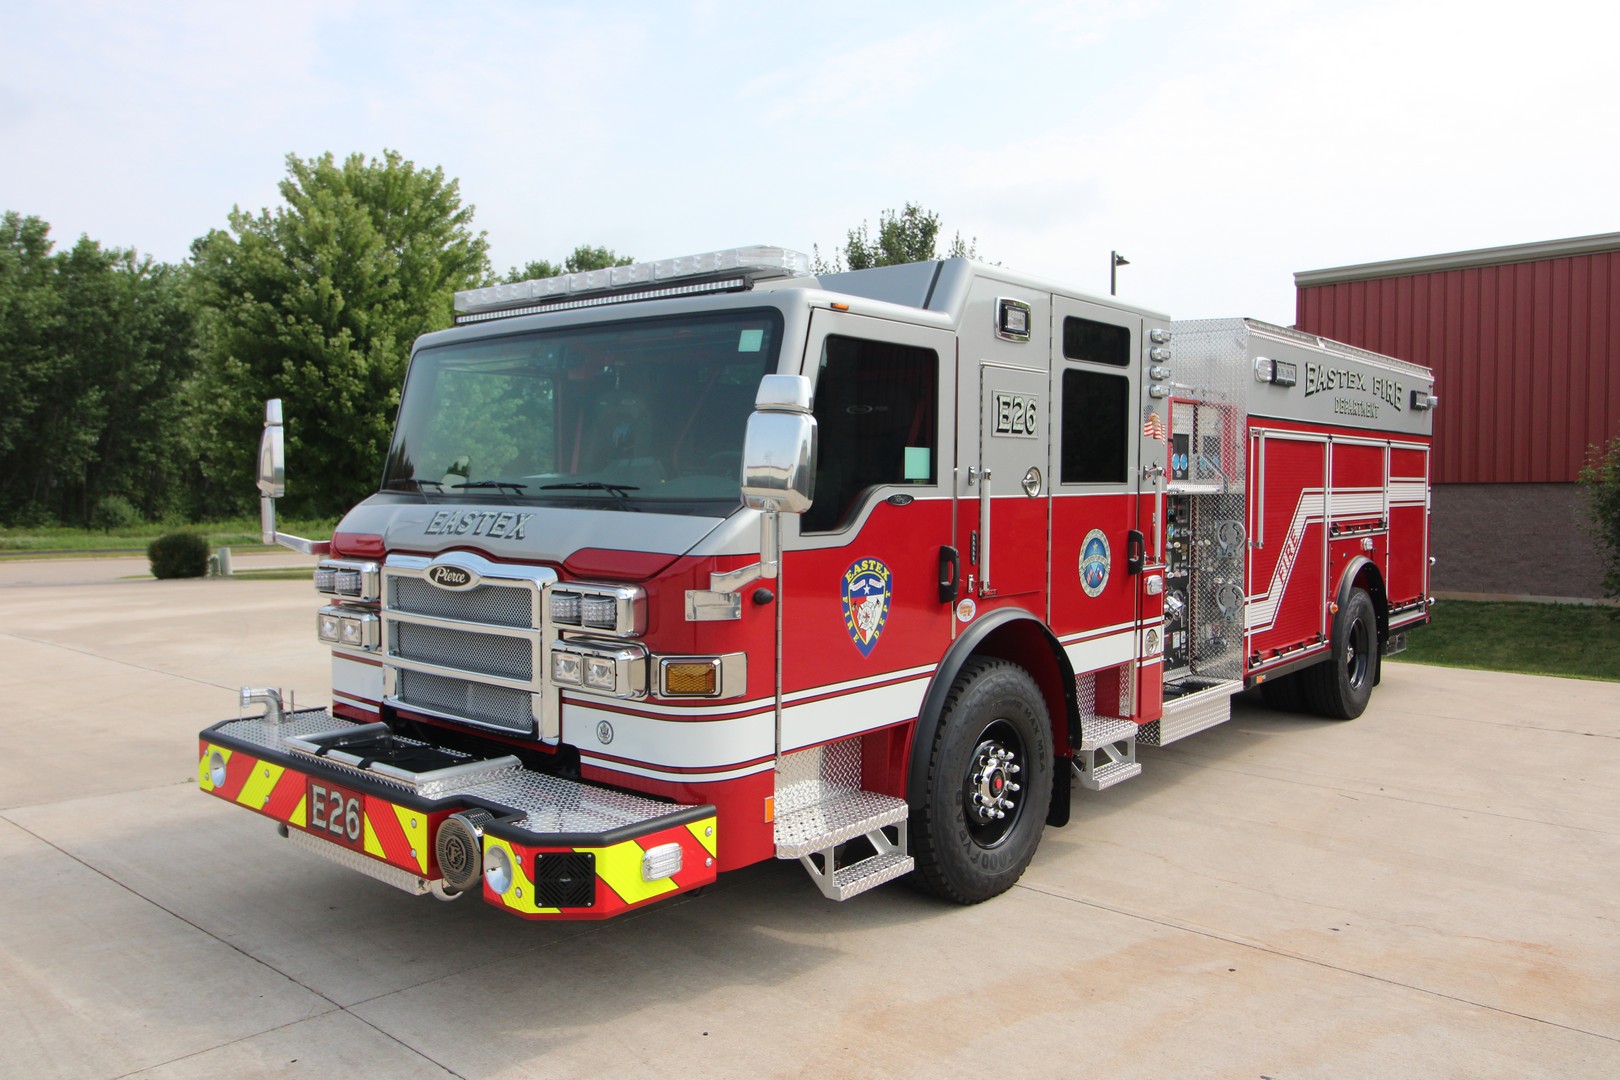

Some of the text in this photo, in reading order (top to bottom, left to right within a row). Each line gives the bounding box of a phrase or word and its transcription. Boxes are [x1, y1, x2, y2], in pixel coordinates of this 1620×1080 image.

[1305, 361, 1402, 412] EASTEX FIRE
[996, 394, 1037, 435] E26
[1334, 397, 1379, 419] DEPARTMENT
[425, 511, 536, 540] EASTEX
[435, 567, 465, 583] Pierce
[845, 559, 891, 583] EASTEX
[310, 783, 360, 843] E26
[954, 790, 1016, 872] GOODYEAR
